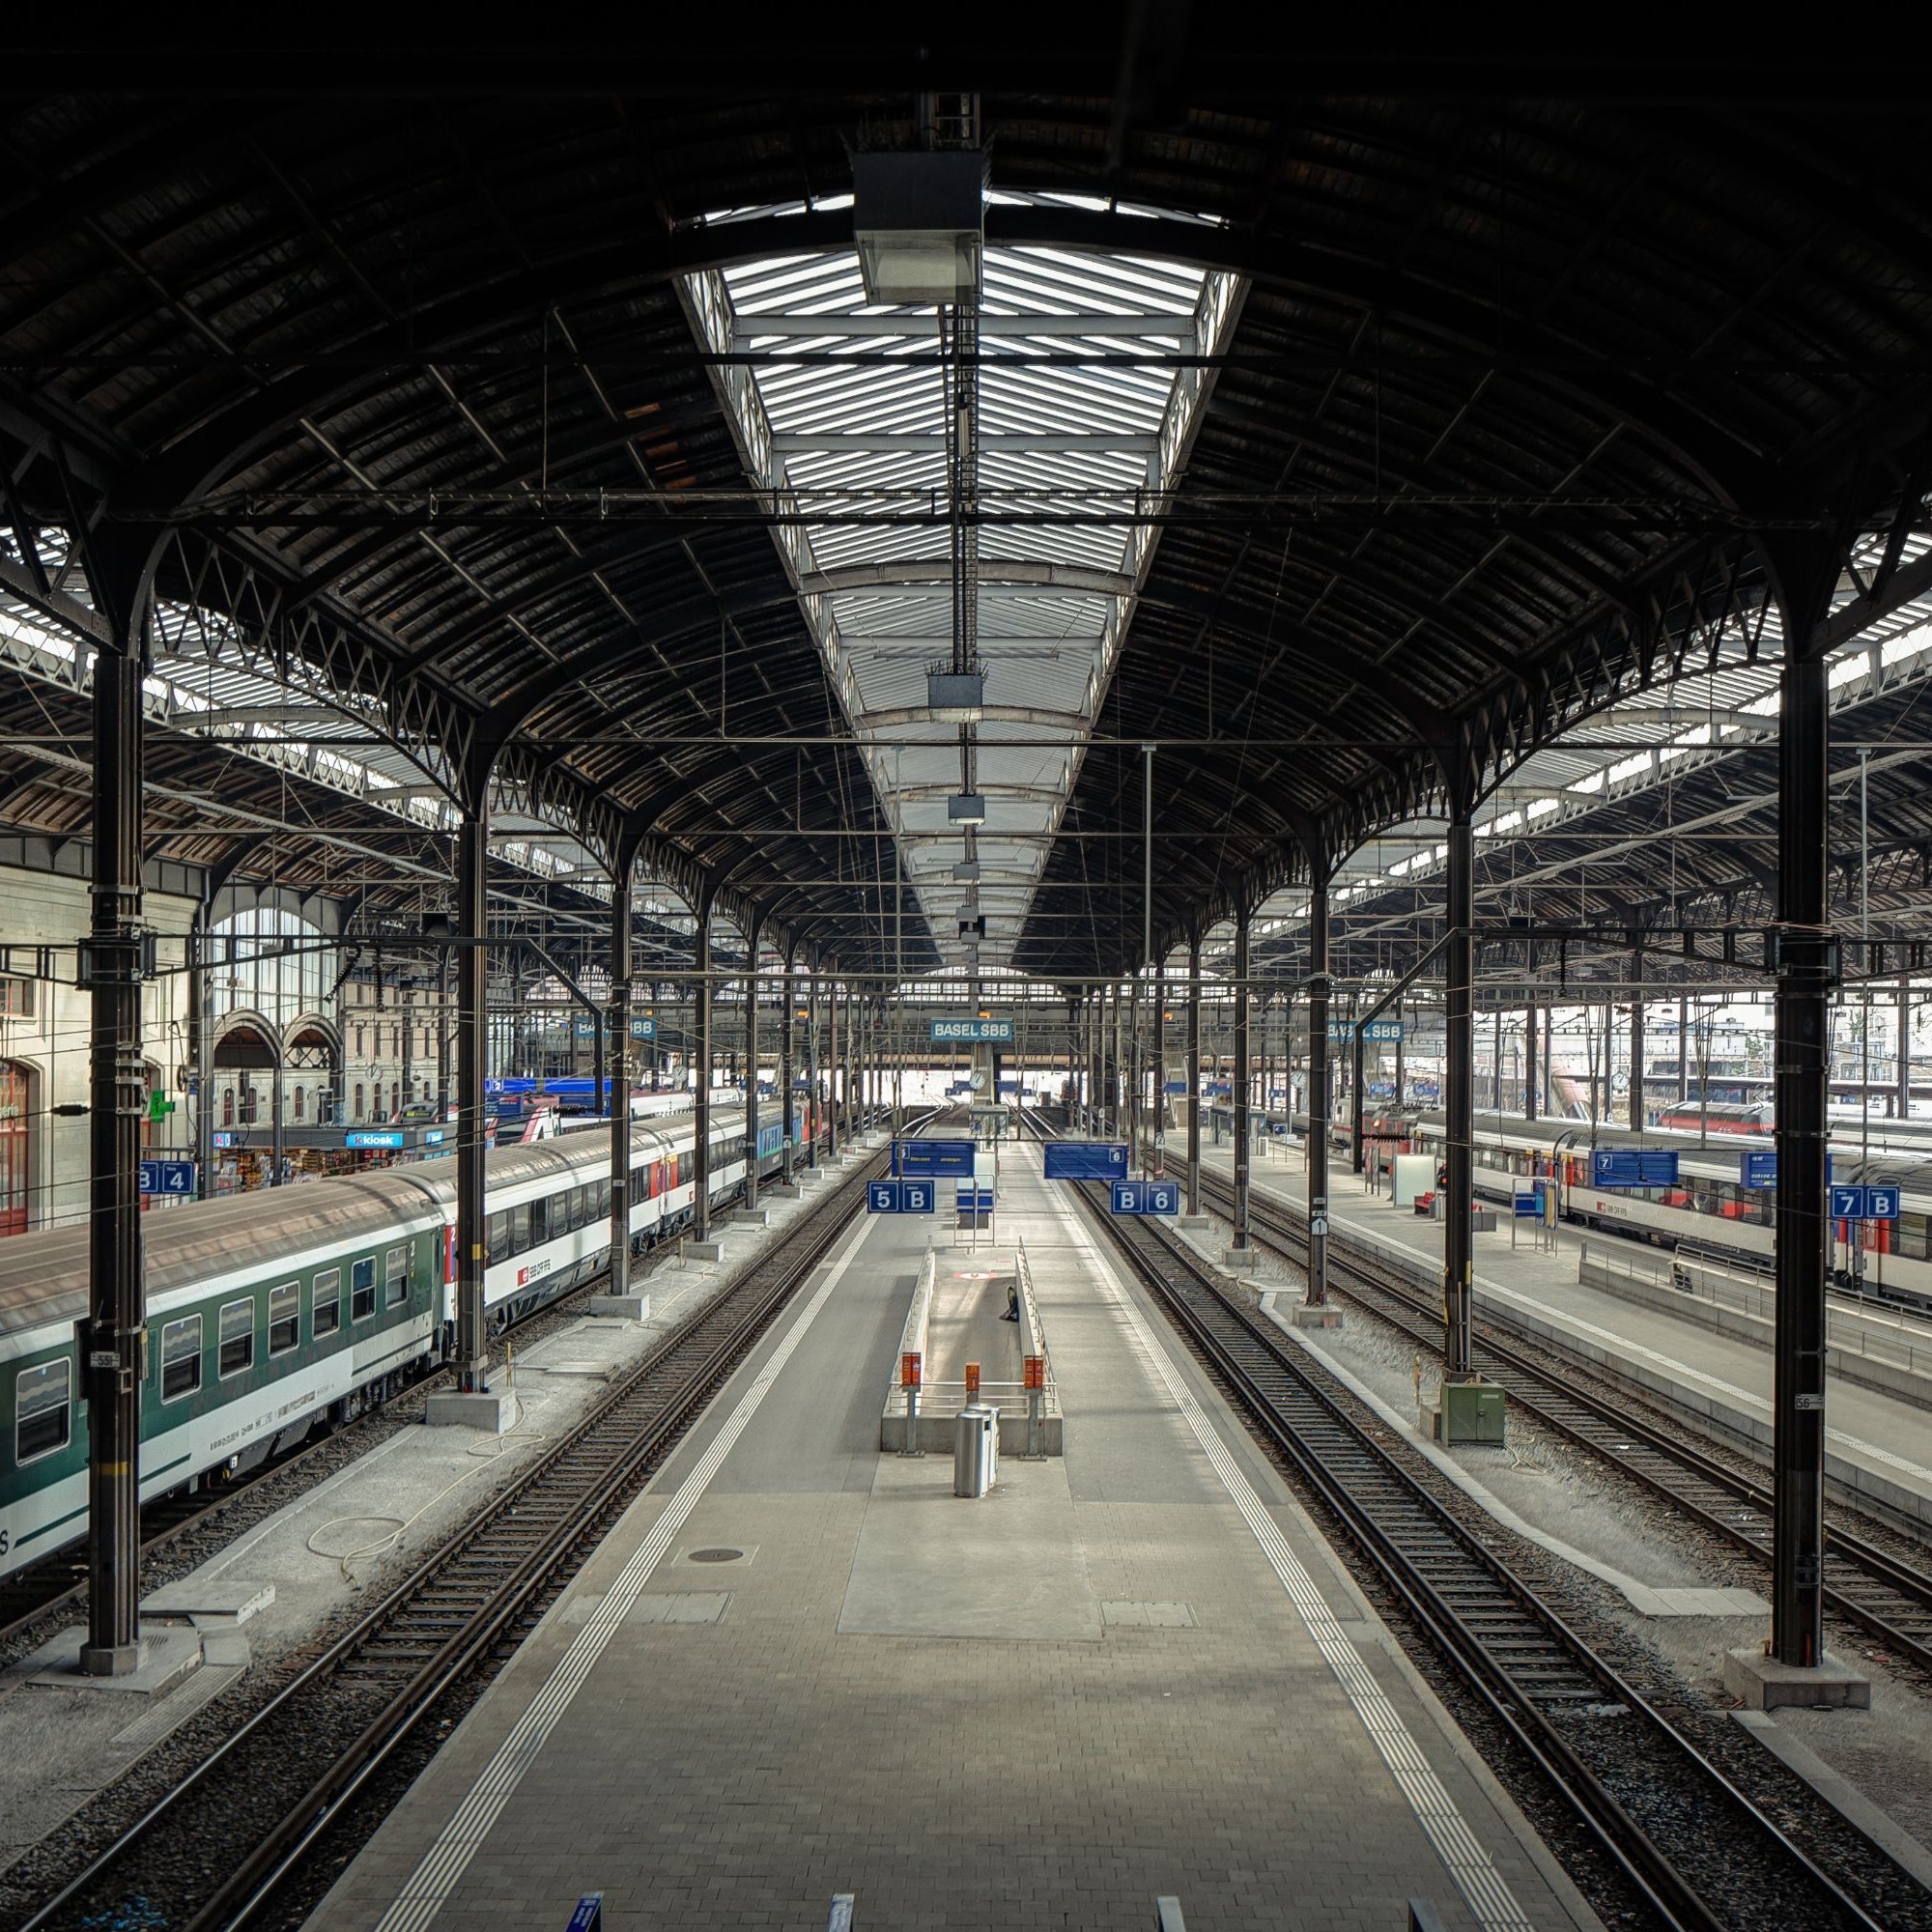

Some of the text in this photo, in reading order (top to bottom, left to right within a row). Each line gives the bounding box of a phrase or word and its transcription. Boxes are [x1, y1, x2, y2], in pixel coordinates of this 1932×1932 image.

[934, 1024, 1009, 1037] BASEL SBB
[1373, 1025, 1401, 1037] SBB
[363, 1135, 394, 1145] kiosk
[1113, 1152, 1121, 1161] 6
[1602, 1158, 1608, 1168] 7
[169, 1172, 184, 1189] 4
[877, 1190, 924, 1208] 5 B
[1121, 1191, 1168, 1209] B 6
[1840, 1196, 1889, 1214] 7 B
[410, 1240, 415, 1257] 2
